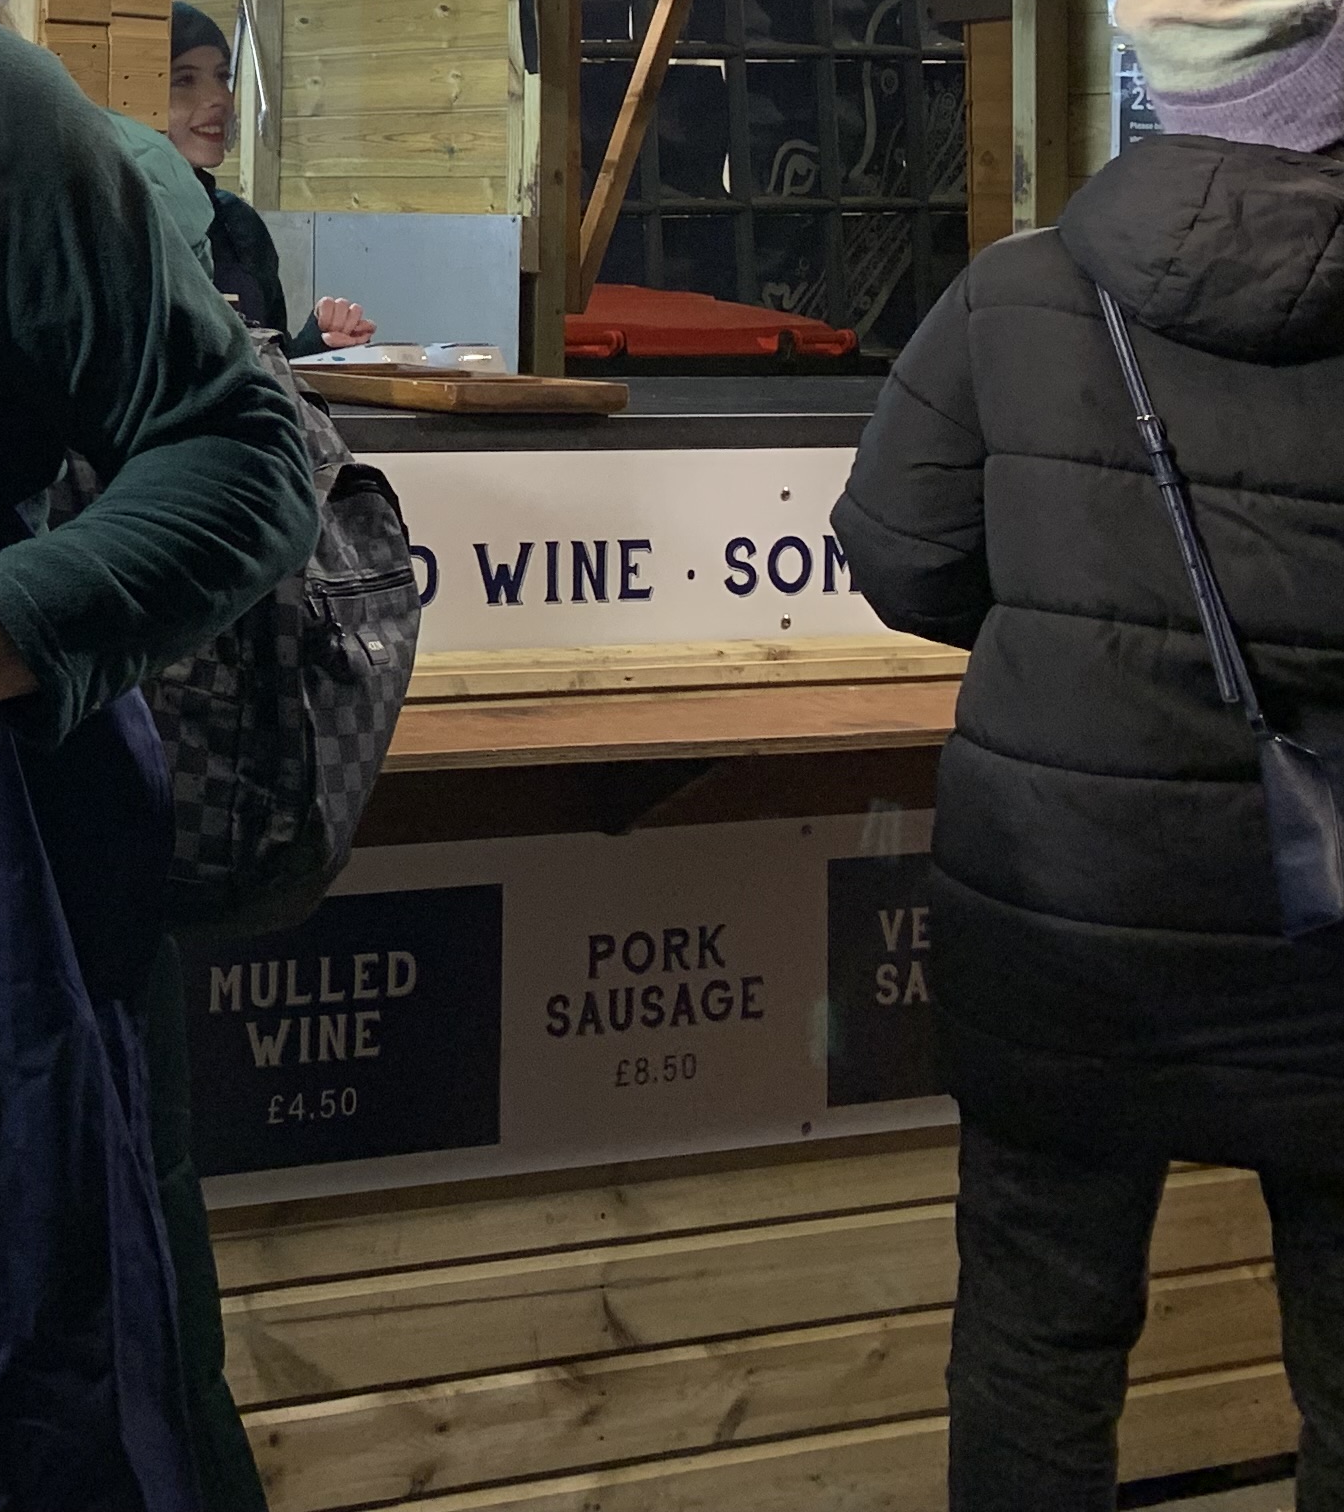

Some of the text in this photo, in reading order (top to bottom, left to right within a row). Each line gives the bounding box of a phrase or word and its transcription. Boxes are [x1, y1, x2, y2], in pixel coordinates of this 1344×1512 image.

[472, 539, 653, 606] WINE
[587, 924, 728, 980] PORK
[208, 951, 417, 1014] MULLED
[544, 976, 765, 1039] SAUSAGE
[245, 1010, 382, 1068] WINE
[614, 1052, 698, 1088] £8.50
[267, 1087, 358, 1126] £4.50
